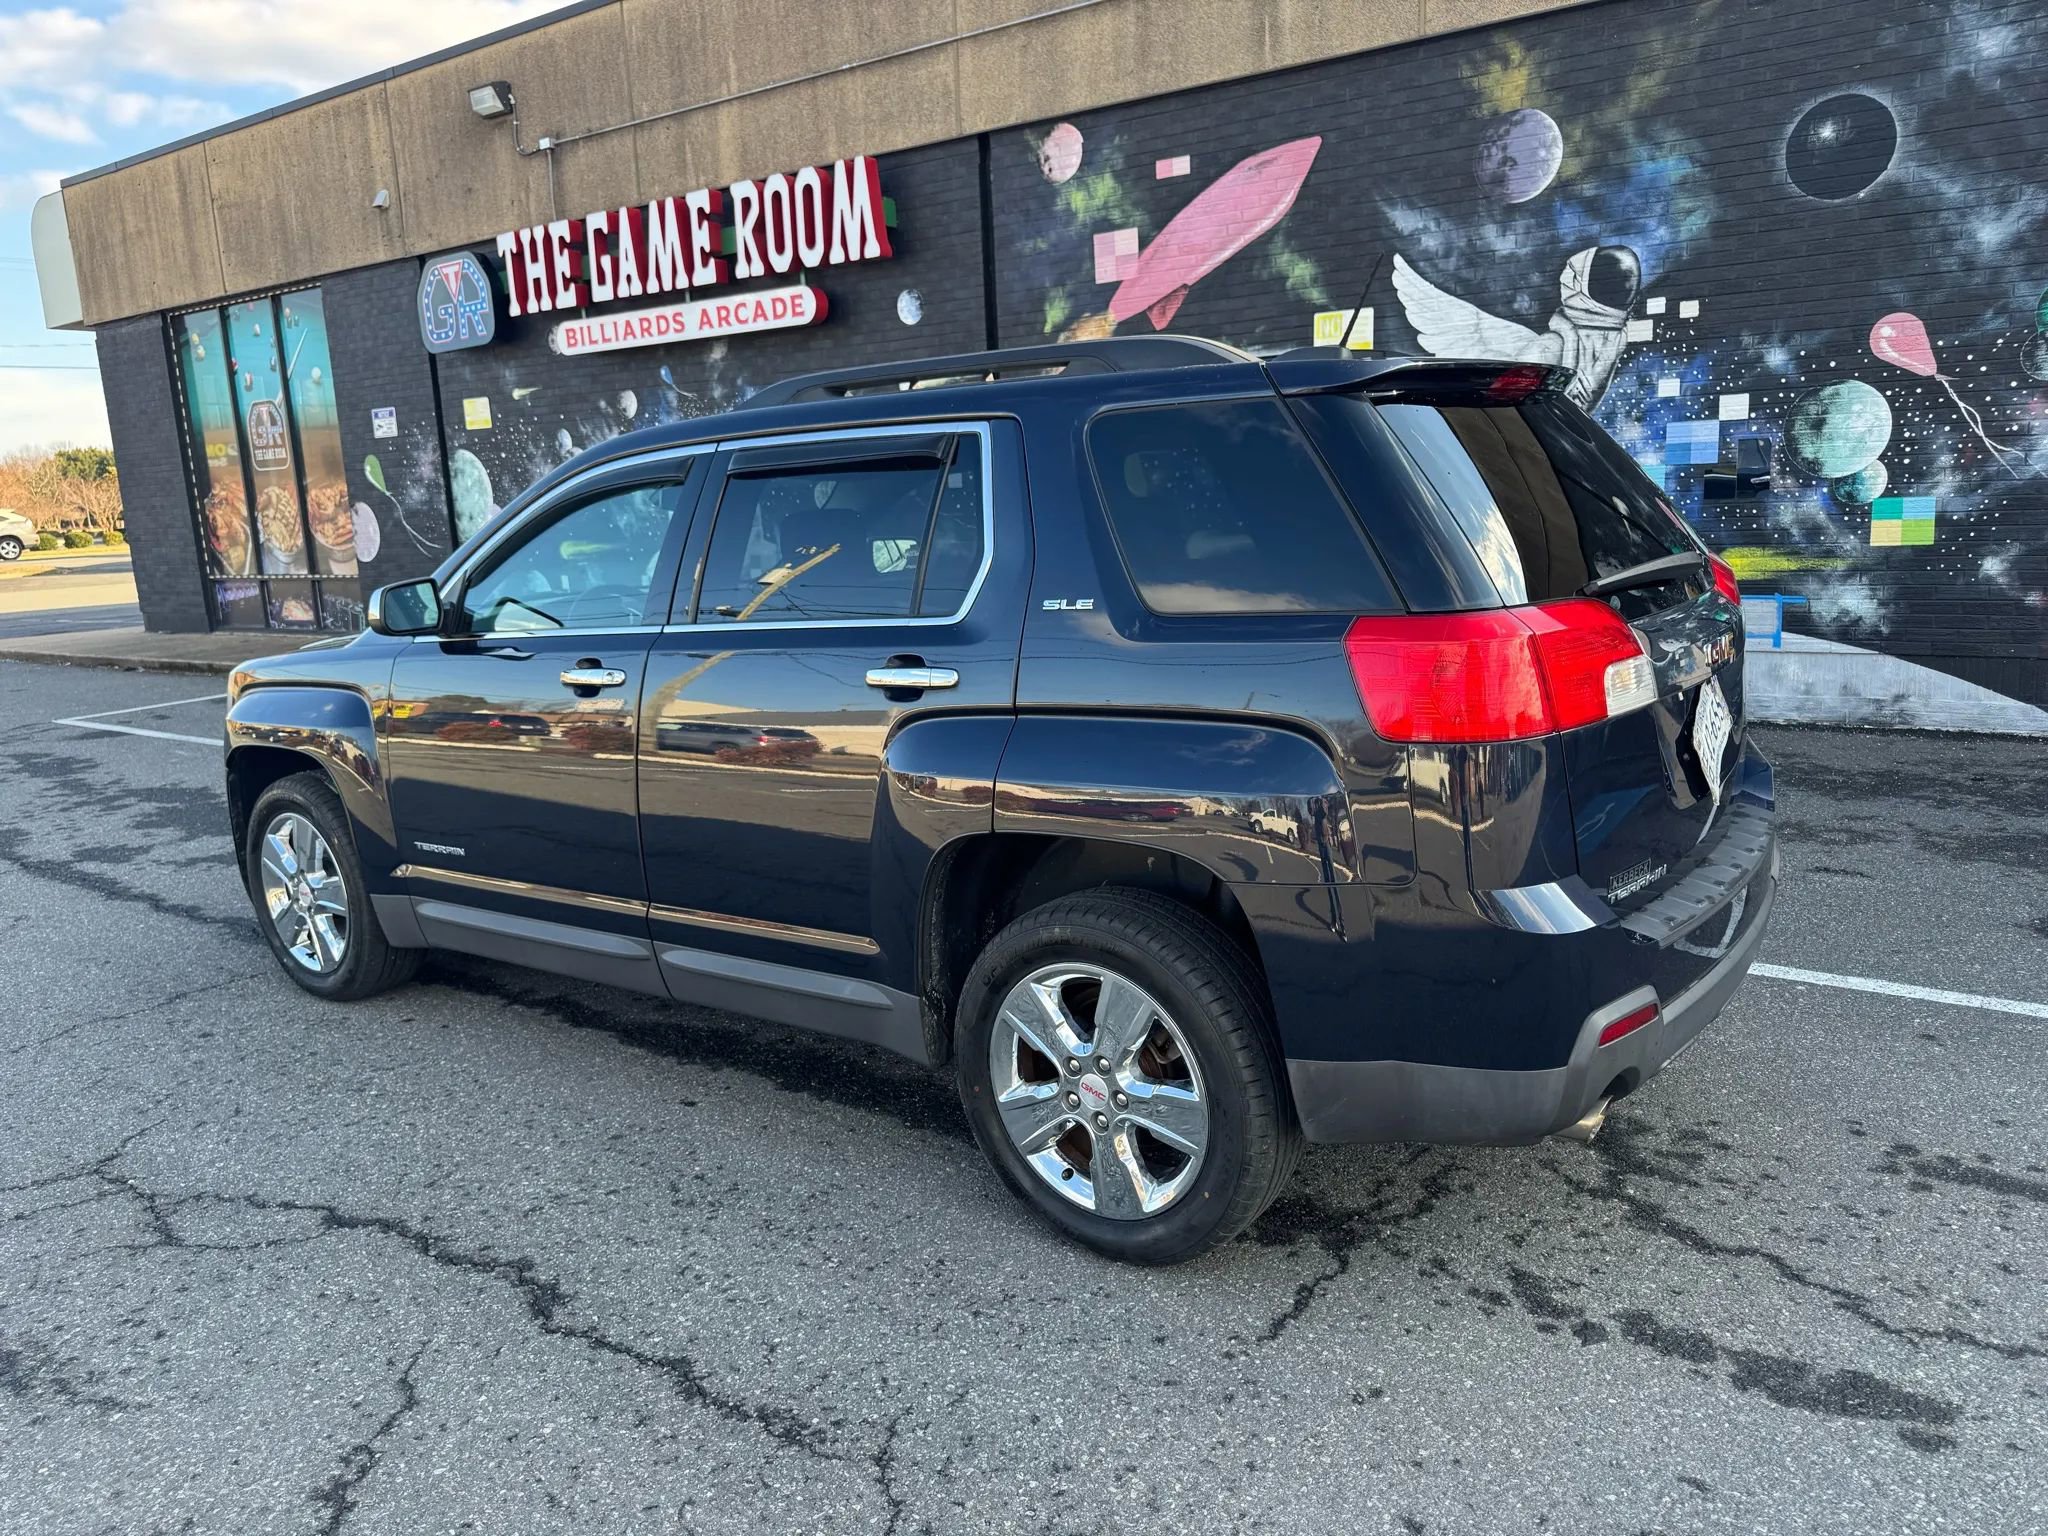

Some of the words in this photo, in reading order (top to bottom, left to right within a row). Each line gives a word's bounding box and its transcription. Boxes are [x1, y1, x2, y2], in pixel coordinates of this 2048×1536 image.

[497, 219, 580, 317] THE
[586, 188, 718, 302] GAME
[730, 155, 882, 279] ROOM
[565, 311, 686, 349] BILLIARDS
[699, 292, 806, 331] ARCADE
[1042, 598, 1095, 610] SLE
[413, 841, 466, 857] TERRAIN
[1608, 864, 1667, 904] TERRAIN
[1081, 1082, 1107, 1102] GMC
